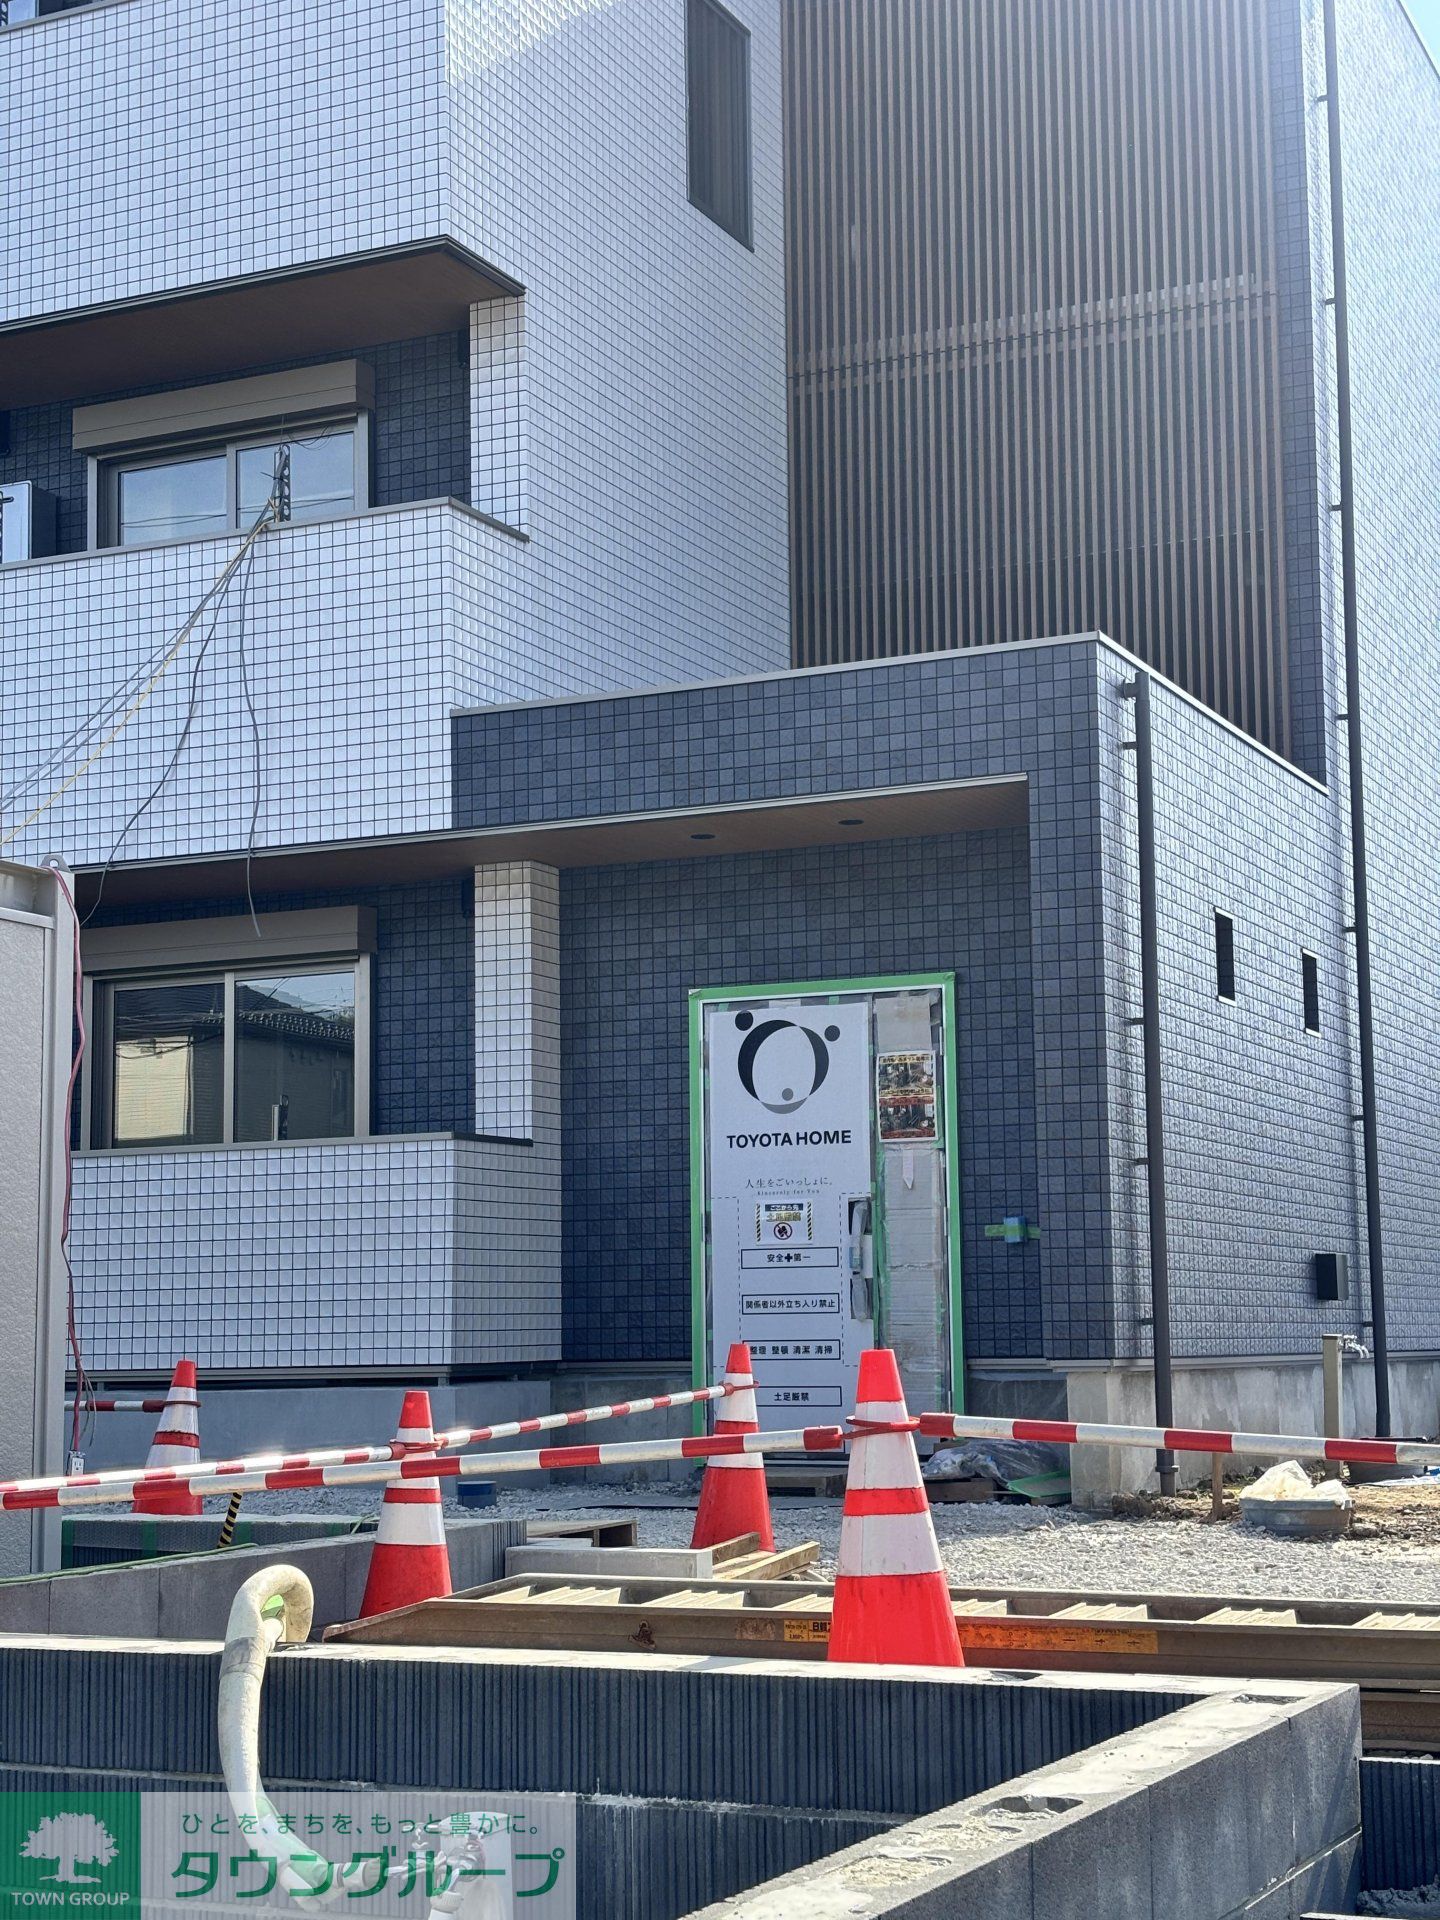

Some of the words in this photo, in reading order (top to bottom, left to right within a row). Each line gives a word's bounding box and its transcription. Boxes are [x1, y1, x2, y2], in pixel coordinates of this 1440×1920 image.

[727, 1133, 792, 1148] TOYOTA
[796, 1130, 851, 1145] HOME
[745, 1299, 836, 1310] 関係者以外立ち入り禁止
[773, 1392, 810, 1402] 土足厳禁
